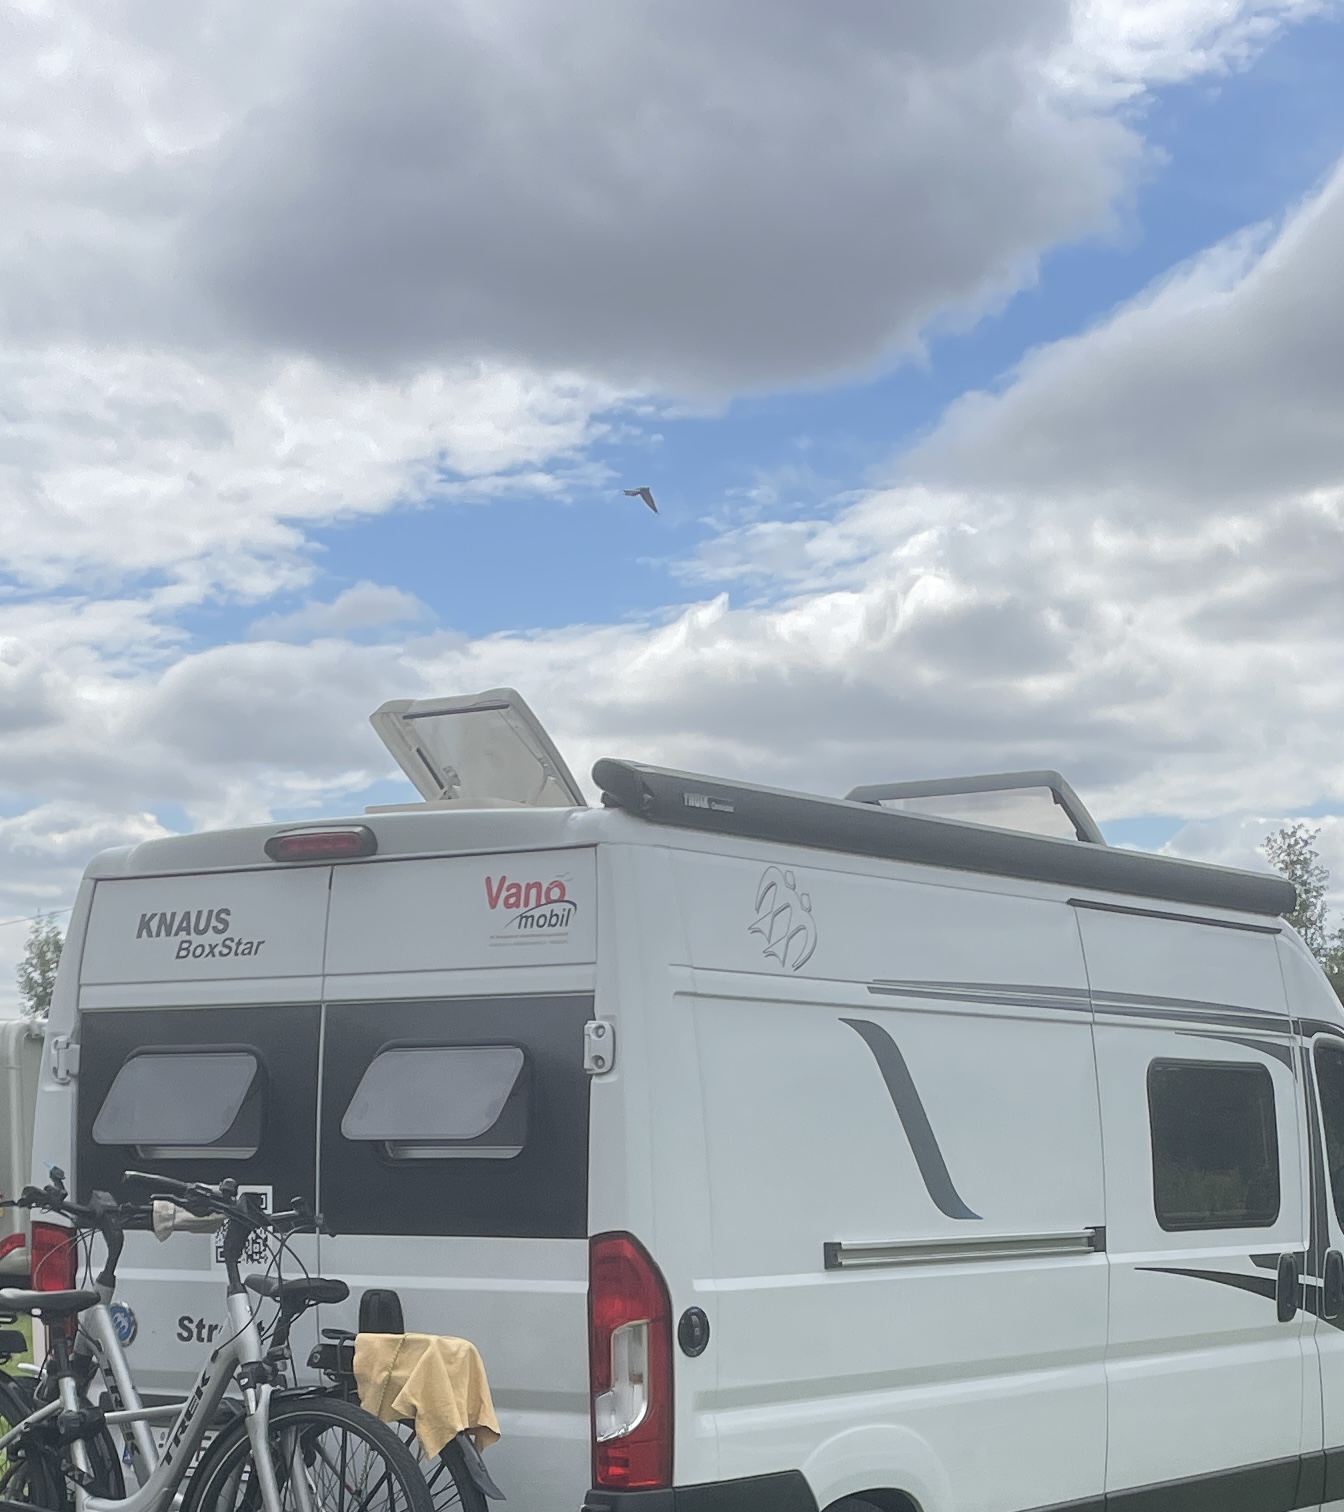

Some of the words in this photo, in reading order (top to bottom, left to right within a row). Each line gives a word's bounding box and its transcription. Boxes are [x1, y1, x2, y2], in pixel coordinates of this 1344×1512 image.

[485, 875, 566, 910] Vano
[136, 908, 232, 940] KNAUS
[517, 907, 572, 930] mobil
[174, 937, 266, 960] BoxStar
